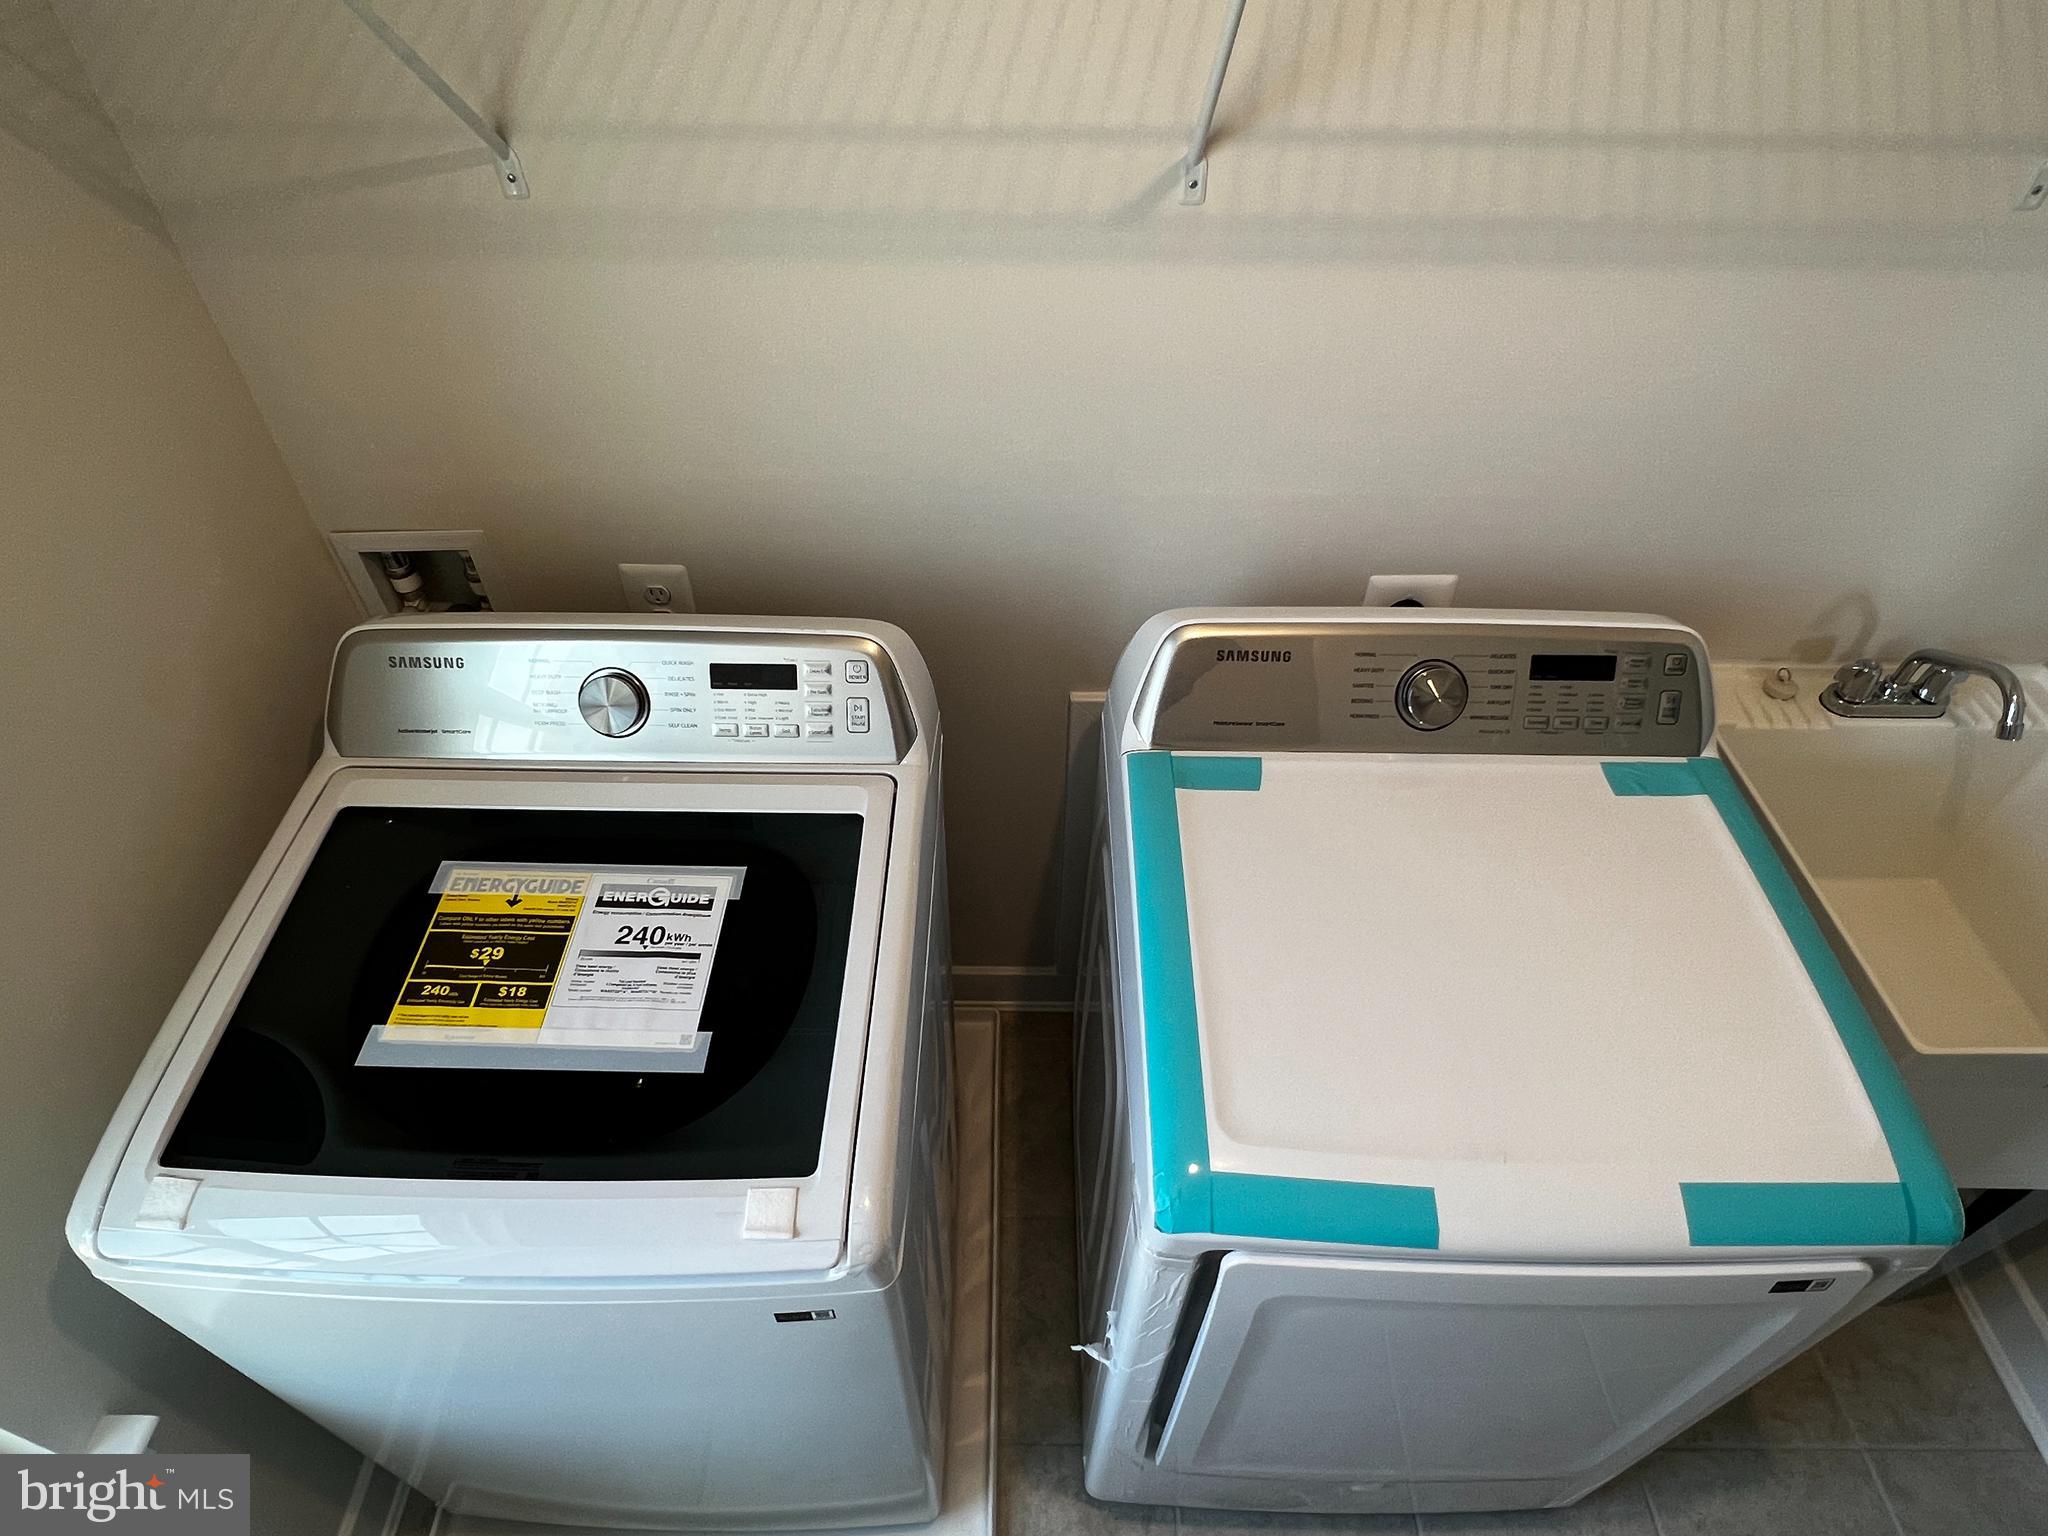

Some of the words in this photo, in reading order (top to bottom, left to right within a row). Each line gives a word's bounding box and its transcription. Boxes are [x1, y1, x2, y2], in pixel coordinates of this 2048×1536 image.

[388, 656, 465, 669] SAMSUNG
[1216, 650, 1292, 662] SAMSUNG
[450, 877, 585, 894] ENERGYGUIDE
[614, 926, 666, 945] 240
[666, 932, 692, 942] kWh
[470, 947, 505, 961] $29
[421, 985, 450, 996] 240
[498, 986, 527, 997] $18
